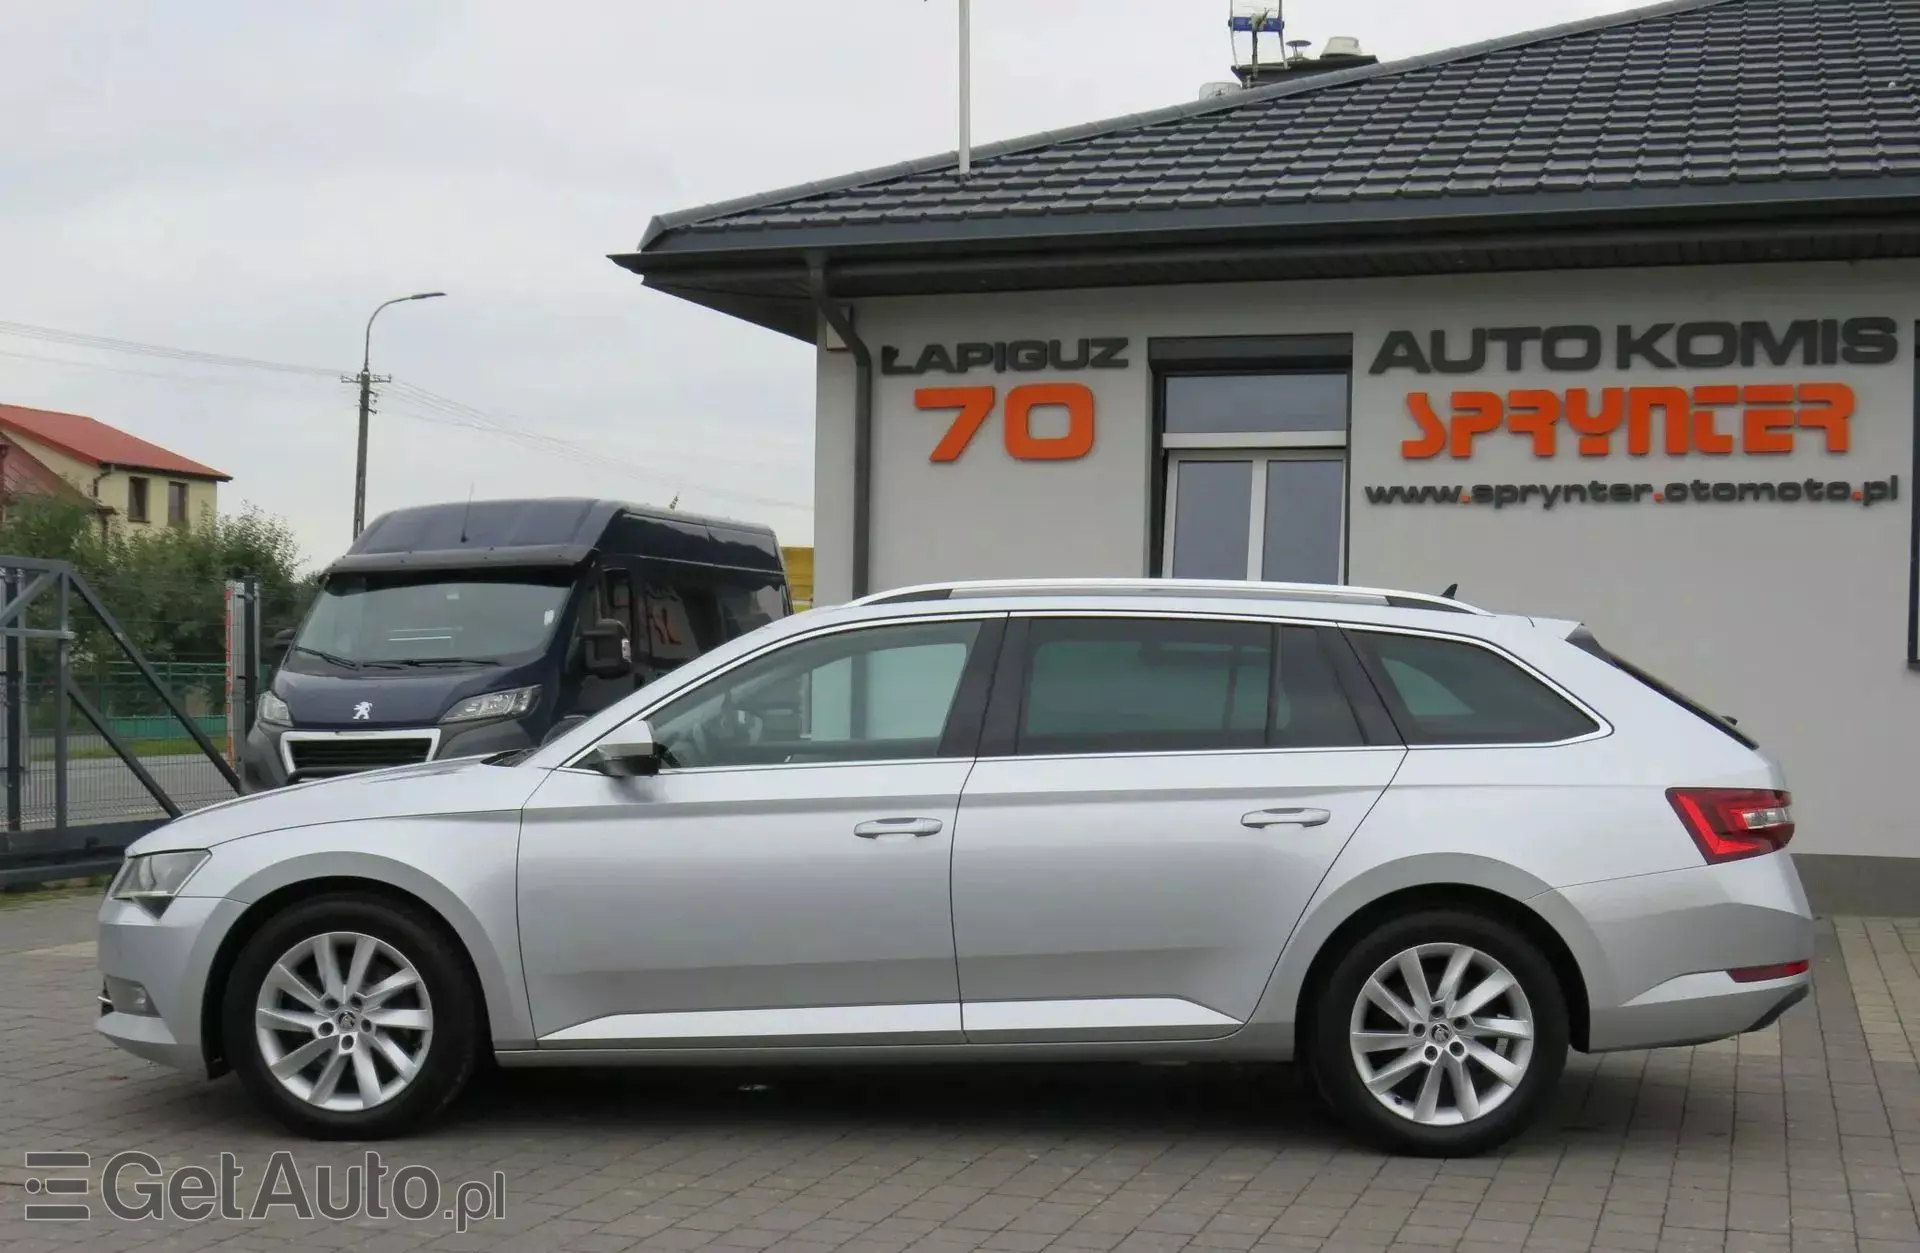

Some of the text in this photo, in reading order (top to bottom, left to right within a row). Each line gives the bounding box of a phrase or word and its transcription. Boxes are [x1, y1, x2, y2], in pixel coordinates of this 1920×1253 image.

[881, 337, 1129, 376] ŁAPIGUZ
[1368, 316, 1898, 375] AUTO KOMIS
[914, 383, 1095, 464] 70
[1401, 382, 1857, 460] SPRYNTER
[1364, 474, 1899, 511] www.sprynter.otomoto.pl
